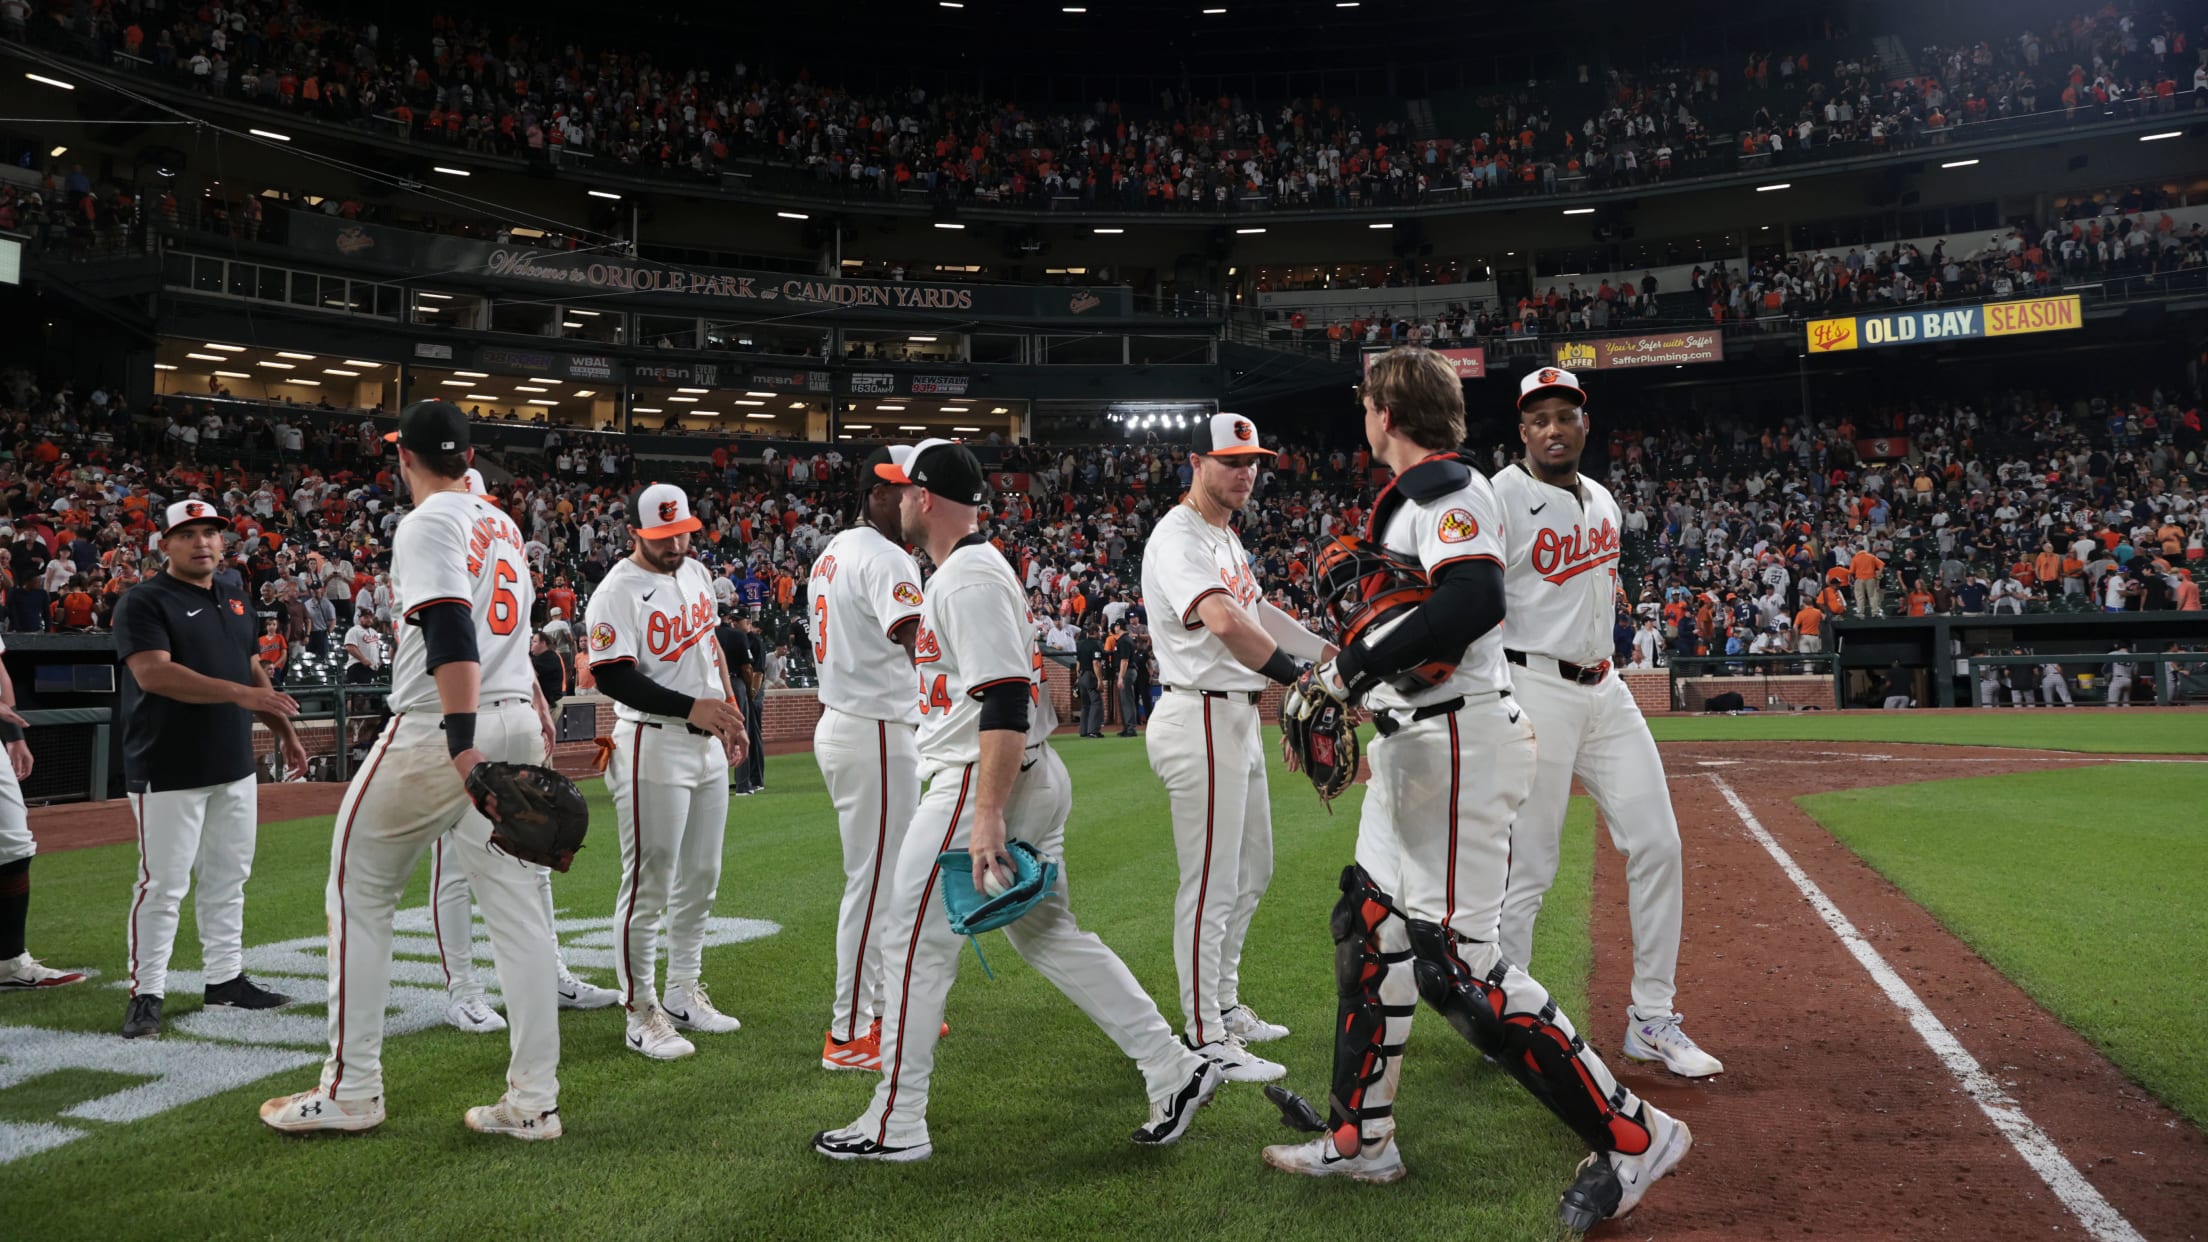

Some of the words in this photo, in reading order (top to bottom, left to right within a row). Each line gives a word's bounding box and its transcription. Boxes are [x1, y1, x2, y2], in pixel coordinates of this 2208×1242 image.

[488, 249, 566, 282] Welcome
[569, 267, 586, 283] to
[587, 263, 686, 293] ORIOLE
[689, 272, 758, 299] PARK
[783, 280, 890, 306] CAMDEN
[893, 287, 973, 310] YARDS
[1814, 321, 1851, 348] It's
[1865, 316, 1916, 344] OLD
[1923, 310, 1974, 338] BAY
[1991, 301, 2074, 332] SEASON
[1605, 341, 1637, 355] You're
[1636, 339, 1662, 352] Safer
[1663, 337, 1685, 349] with
[1684, 335, 1713, 350] Saffer
[572, 357, 609, 368] WBAL
[1462, 357, 1479, 367] You.
[1561, 358, 1593, 369] SAFFER
[1612, 351, 1712, 366] SafferPlumbing.com
[635, 366, 690, 379] masn
[695, 364, 718, 375] EVERY
[852, 373, 894, 385] ESPN
[913, 375, 969, 385] NEWSTALK
[487, 558, 518, 636] 6
[919, 671, 952, 716] 54
